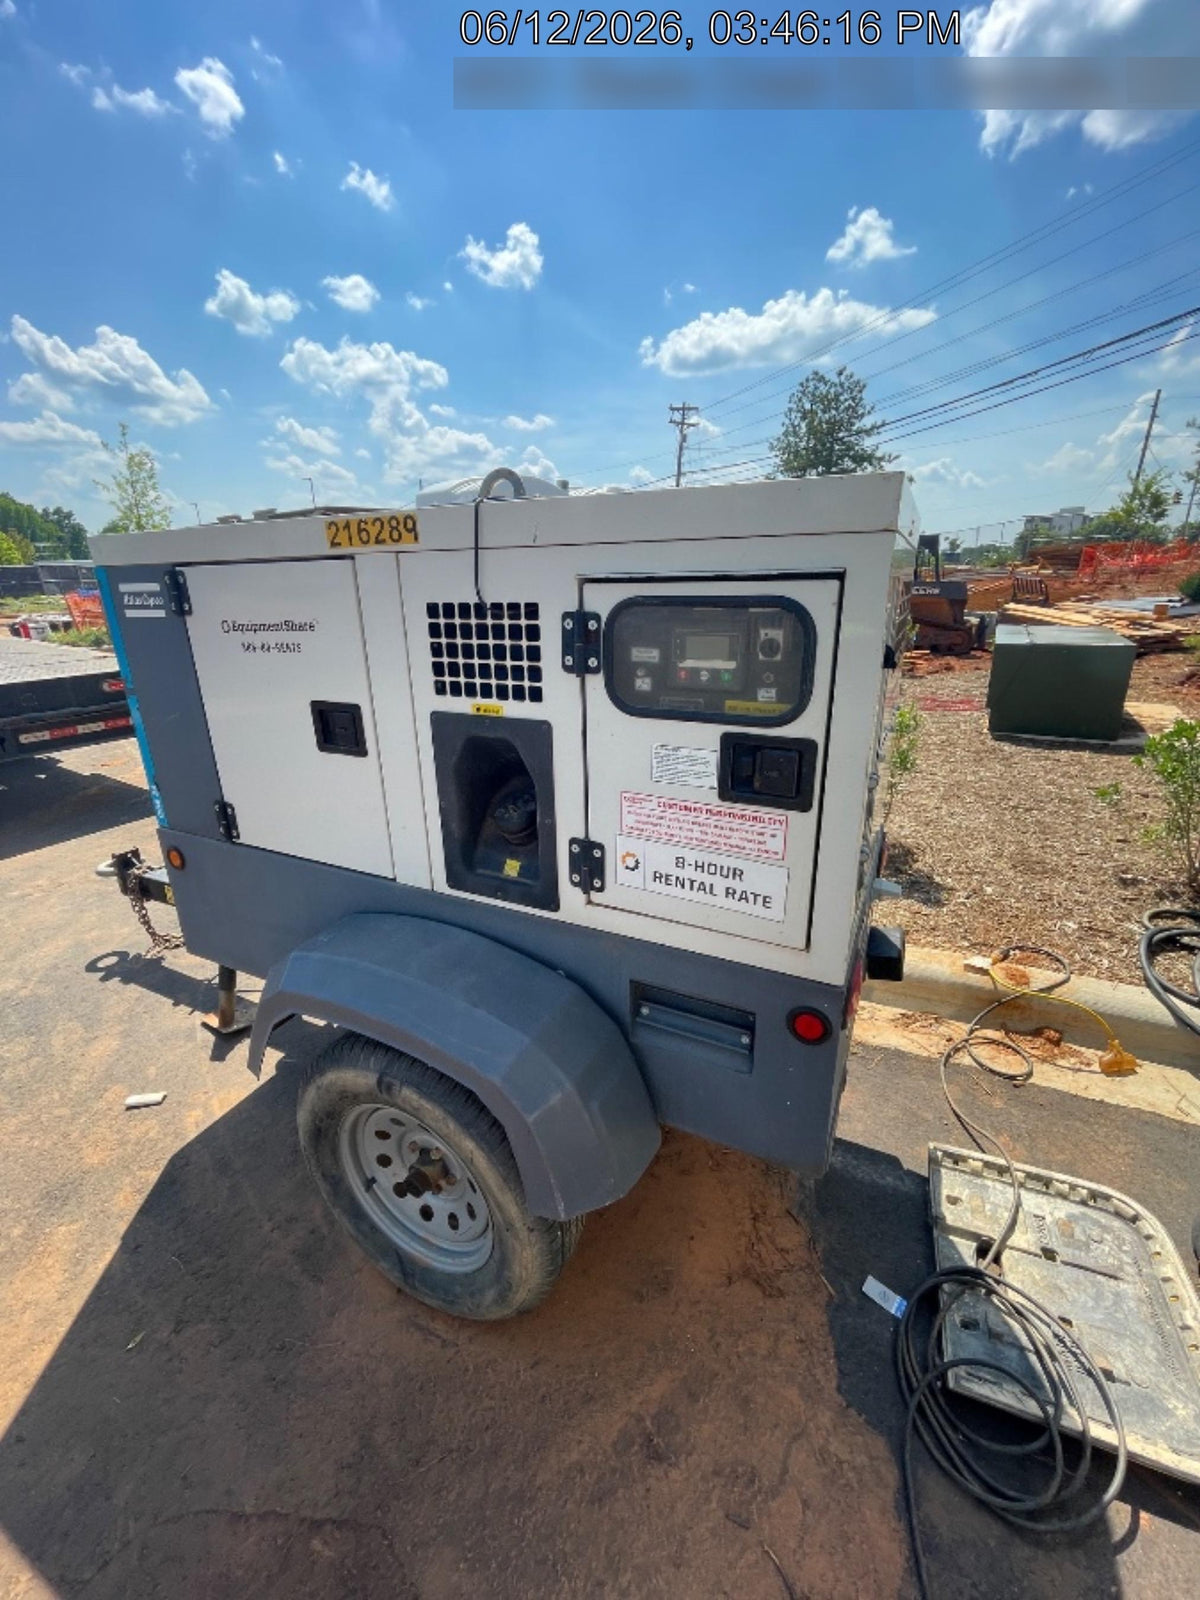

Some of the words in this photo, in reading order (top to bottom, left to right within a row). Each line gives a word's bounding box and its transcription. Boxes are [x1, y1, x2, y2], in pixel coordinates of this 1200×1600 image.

[328, 513, 418, 548] 216289
[674, 855, 744, 882] 8-HOUR
[652, 870, 717, 897] RENTAL
[725, 886, 773, 909] RATE
